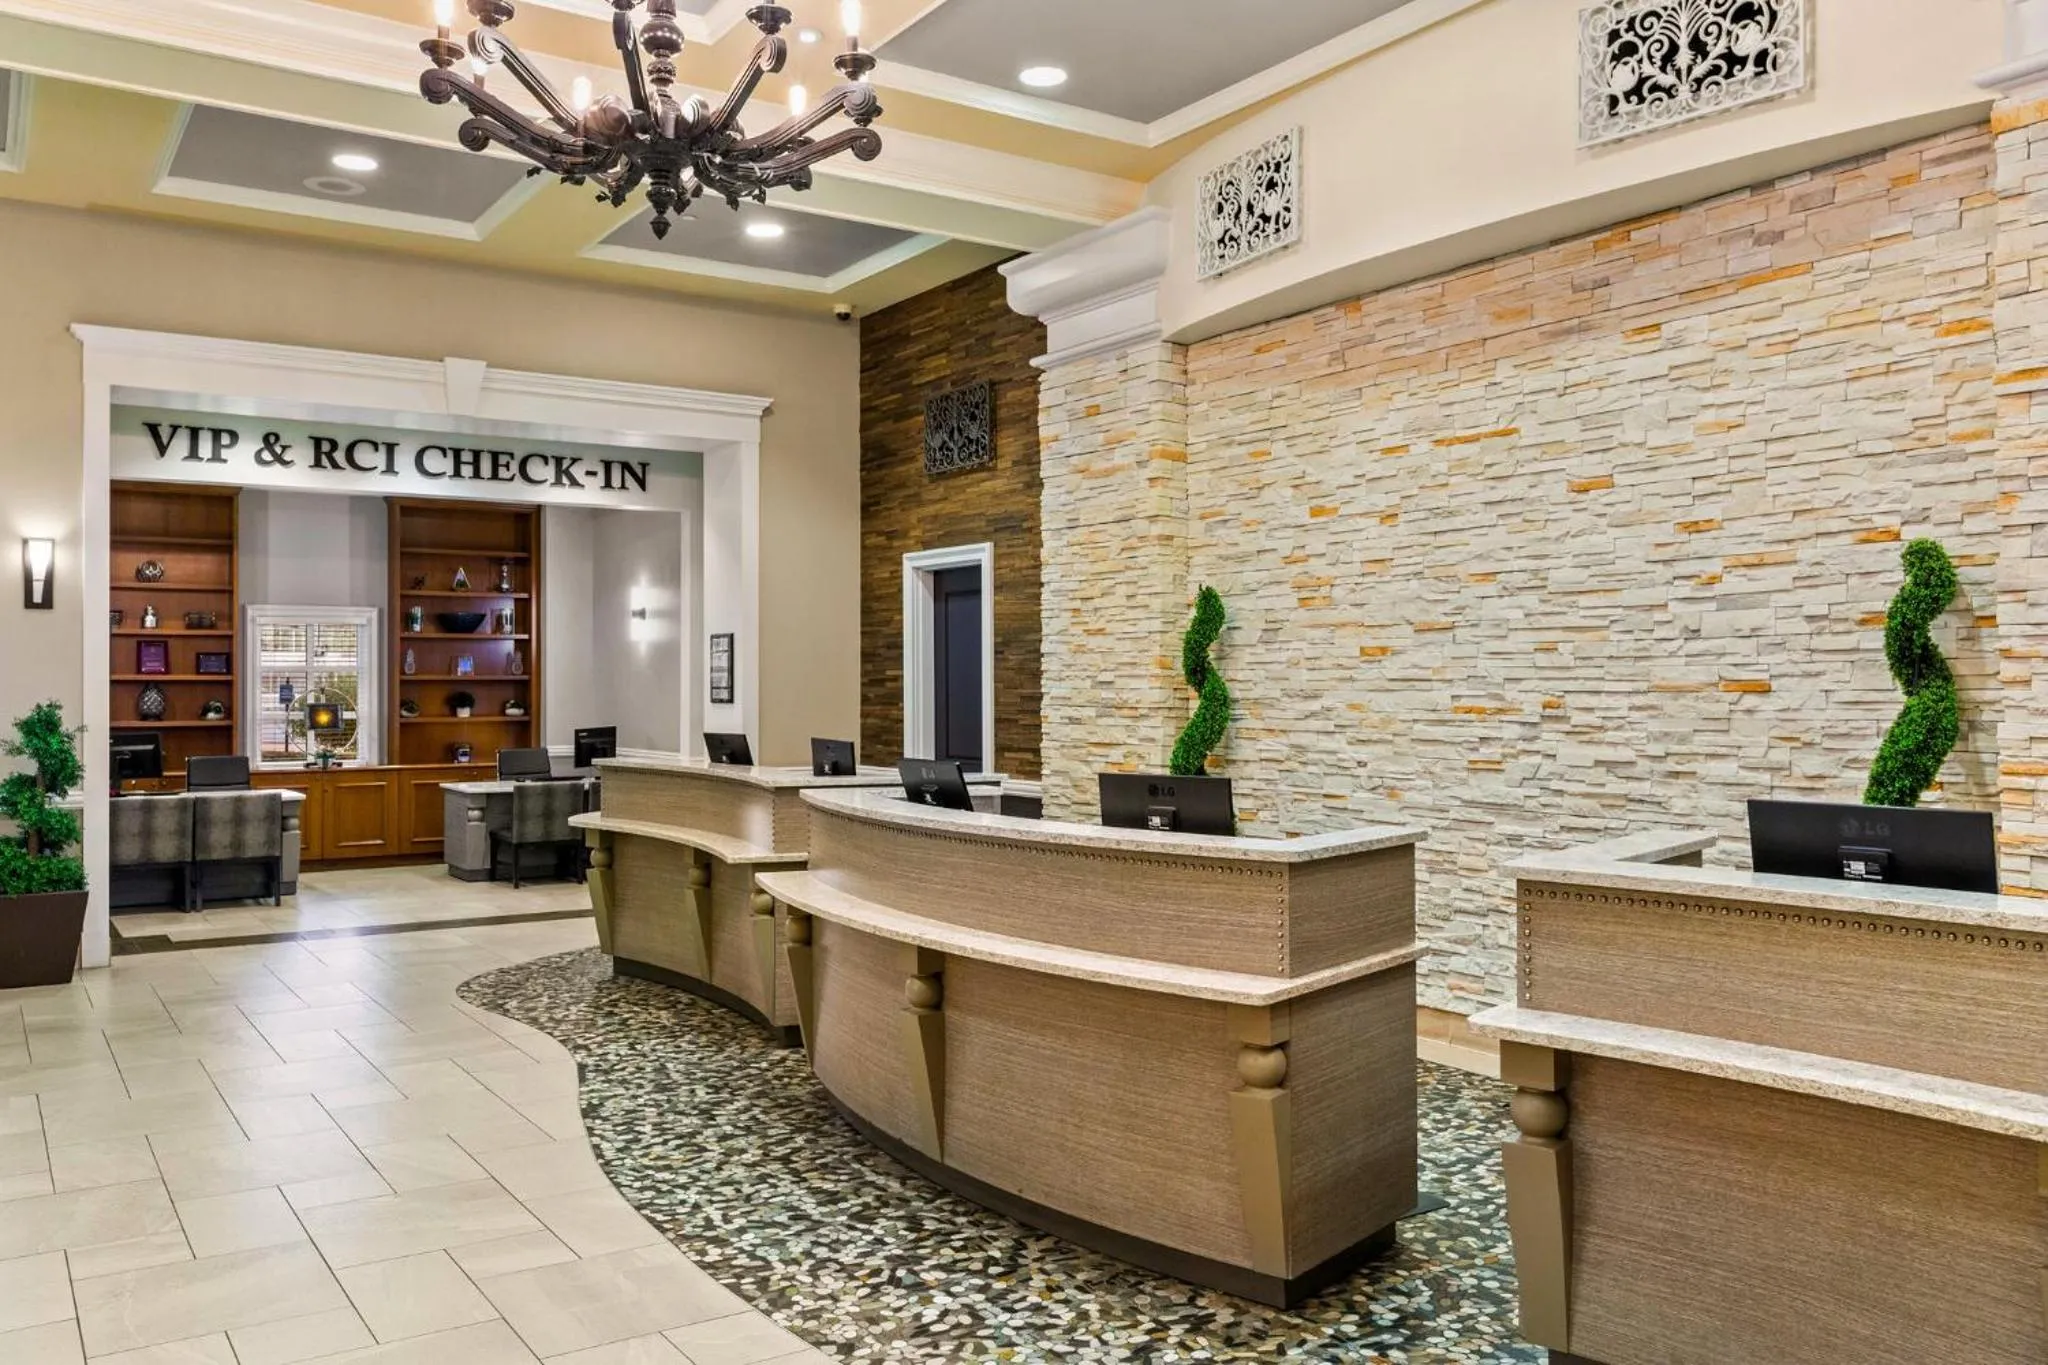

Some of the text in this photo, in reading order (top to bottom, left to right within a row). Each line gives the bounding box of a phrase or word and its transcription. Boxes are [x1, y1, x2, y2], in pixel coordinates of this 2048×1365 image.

[142, 422, 651, 492] VIP & RCI CHECK-IN
[1161, 785, 1176, 798] LG
[1865, 820, 1891, 837] LG
